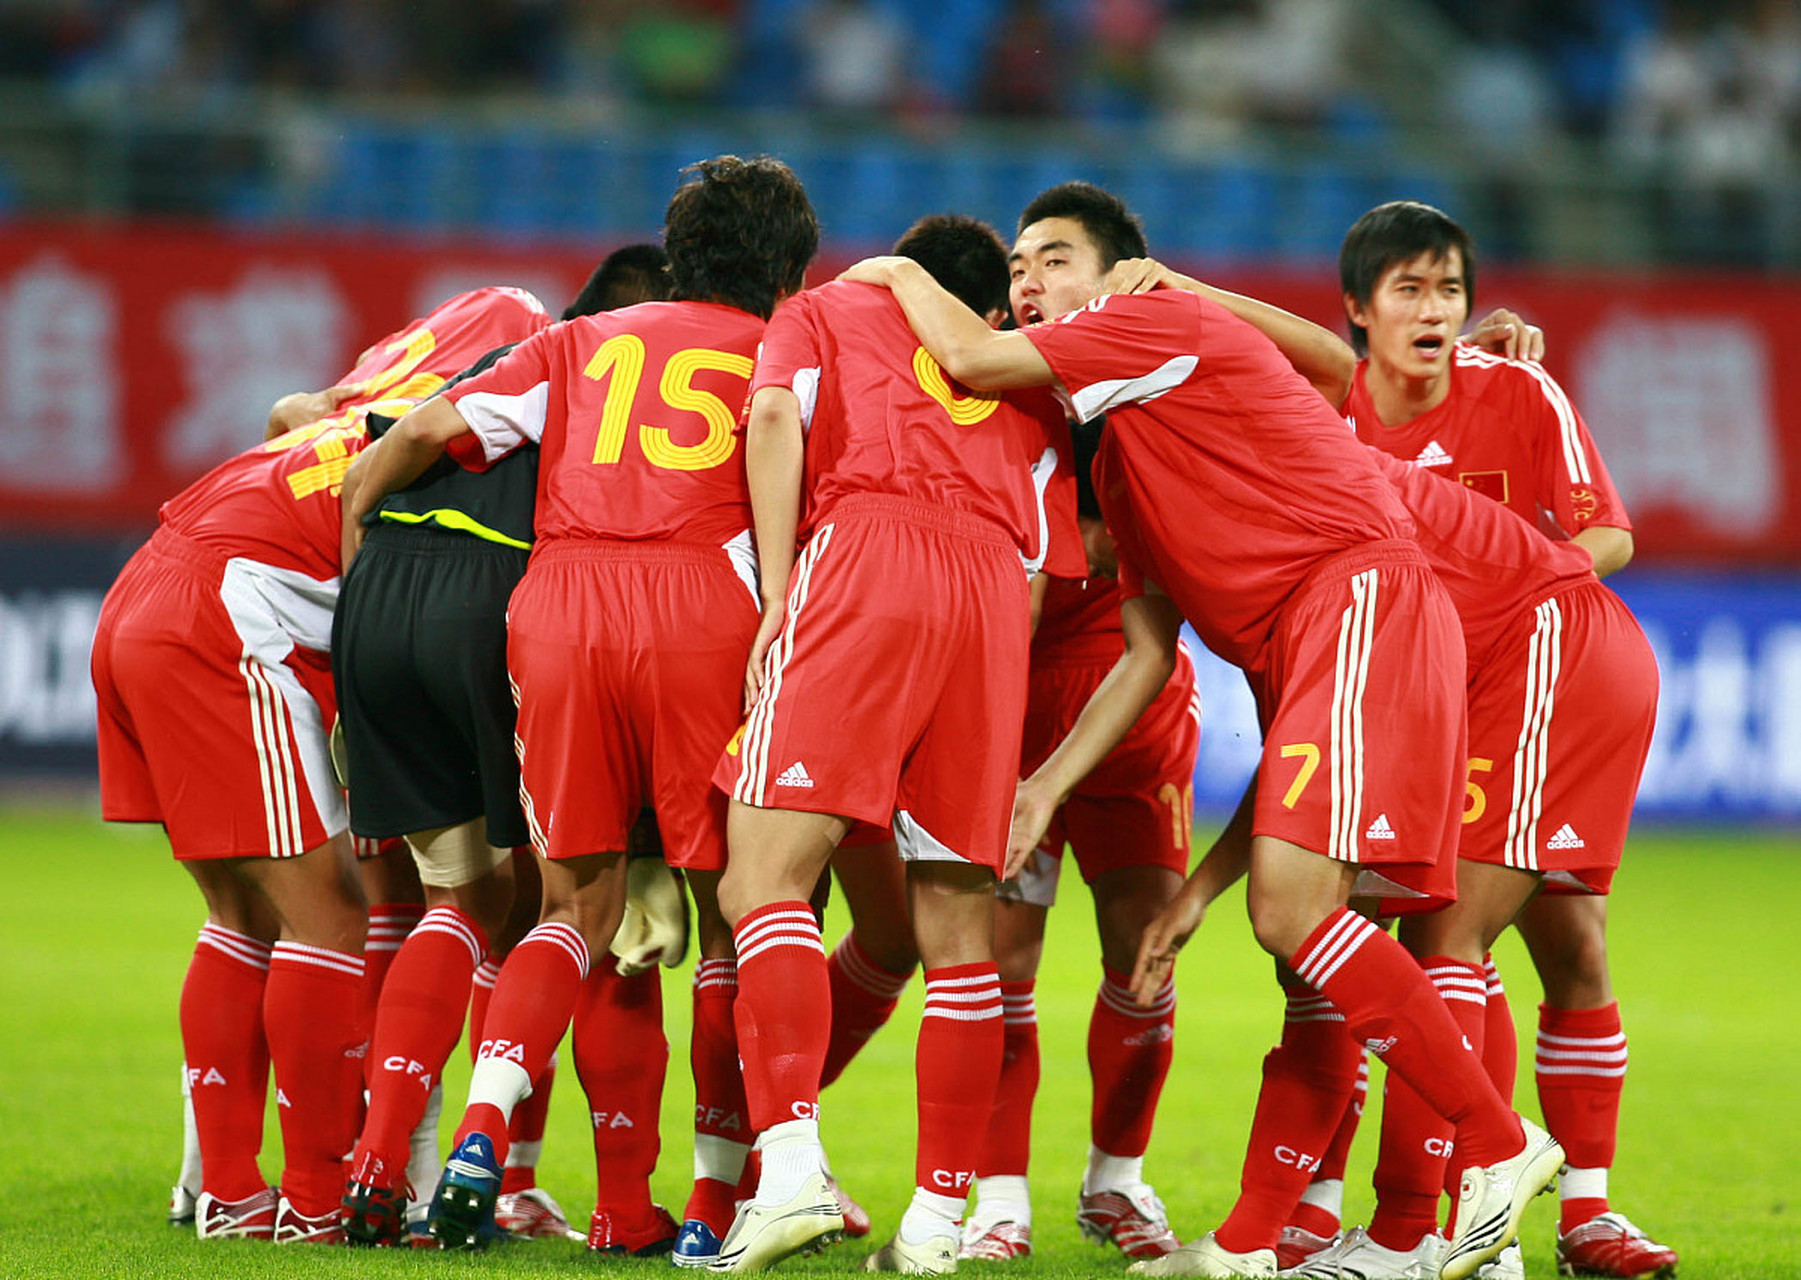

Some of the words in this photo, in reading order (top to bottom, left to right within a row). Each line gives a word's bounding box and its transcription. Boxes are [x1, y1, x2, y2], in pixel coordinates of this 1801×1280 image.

[582, 333, 755, 471] 15
[776, 777, 815, 788] adidas
[1280, 743, 1321, 810] 7
[1546, 839, 1585, 850] adidas
[480, 1039, 524, 1063] CFA
[383, 1055, 432, 1092] CFA
[695, 1104, 740, 1131] CFA
